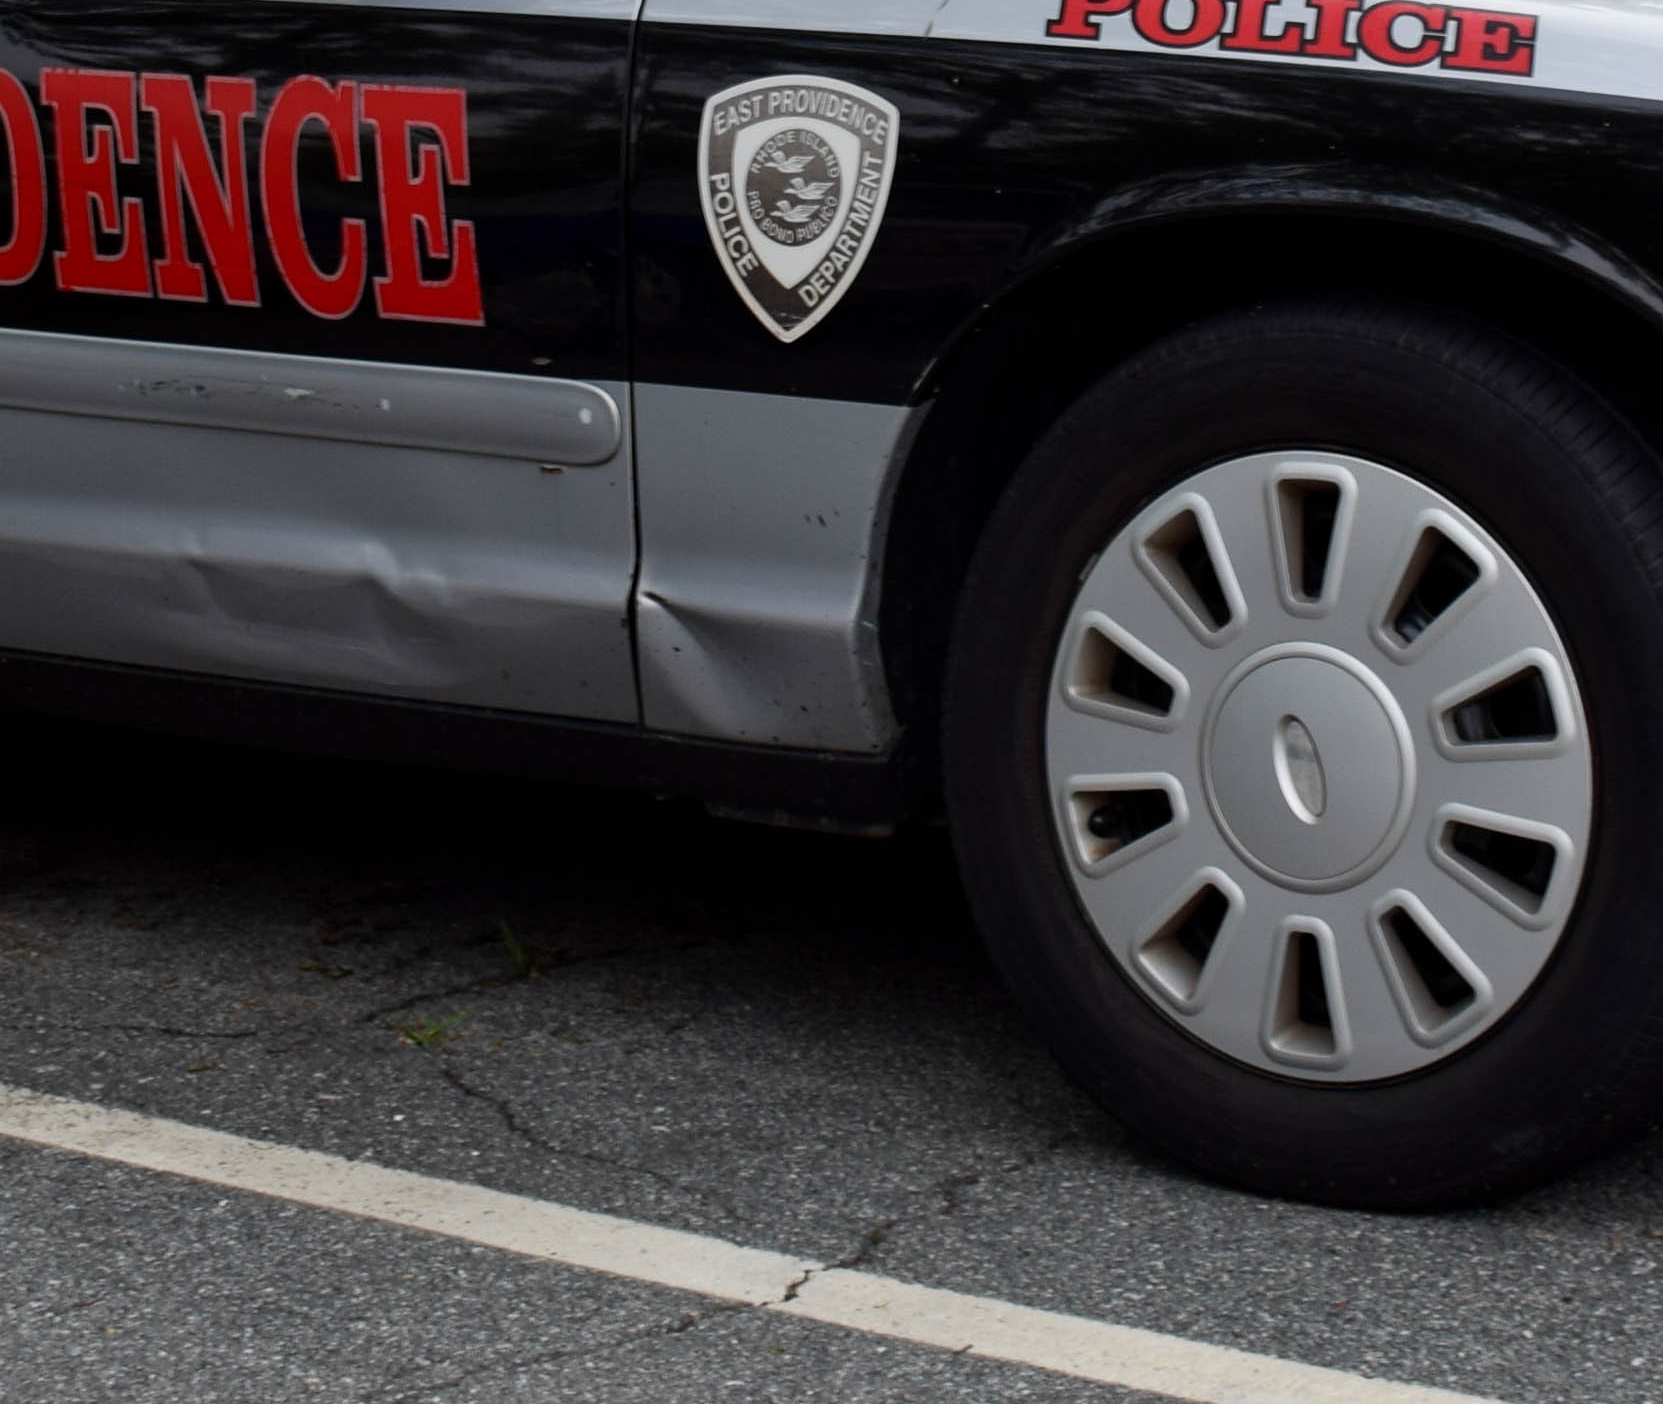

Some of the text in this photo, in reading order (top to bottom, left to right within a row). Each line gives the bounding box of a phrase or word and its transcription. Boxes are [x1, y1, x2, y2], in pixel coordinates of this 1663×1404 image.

[713, 90, 888, 145] EAST PROVIDENCE
[750, 131, 796, 174] RHODE
[709, 172, 759, 278] POLICE
[798, 151, 884, 308] DEPARTMENT
